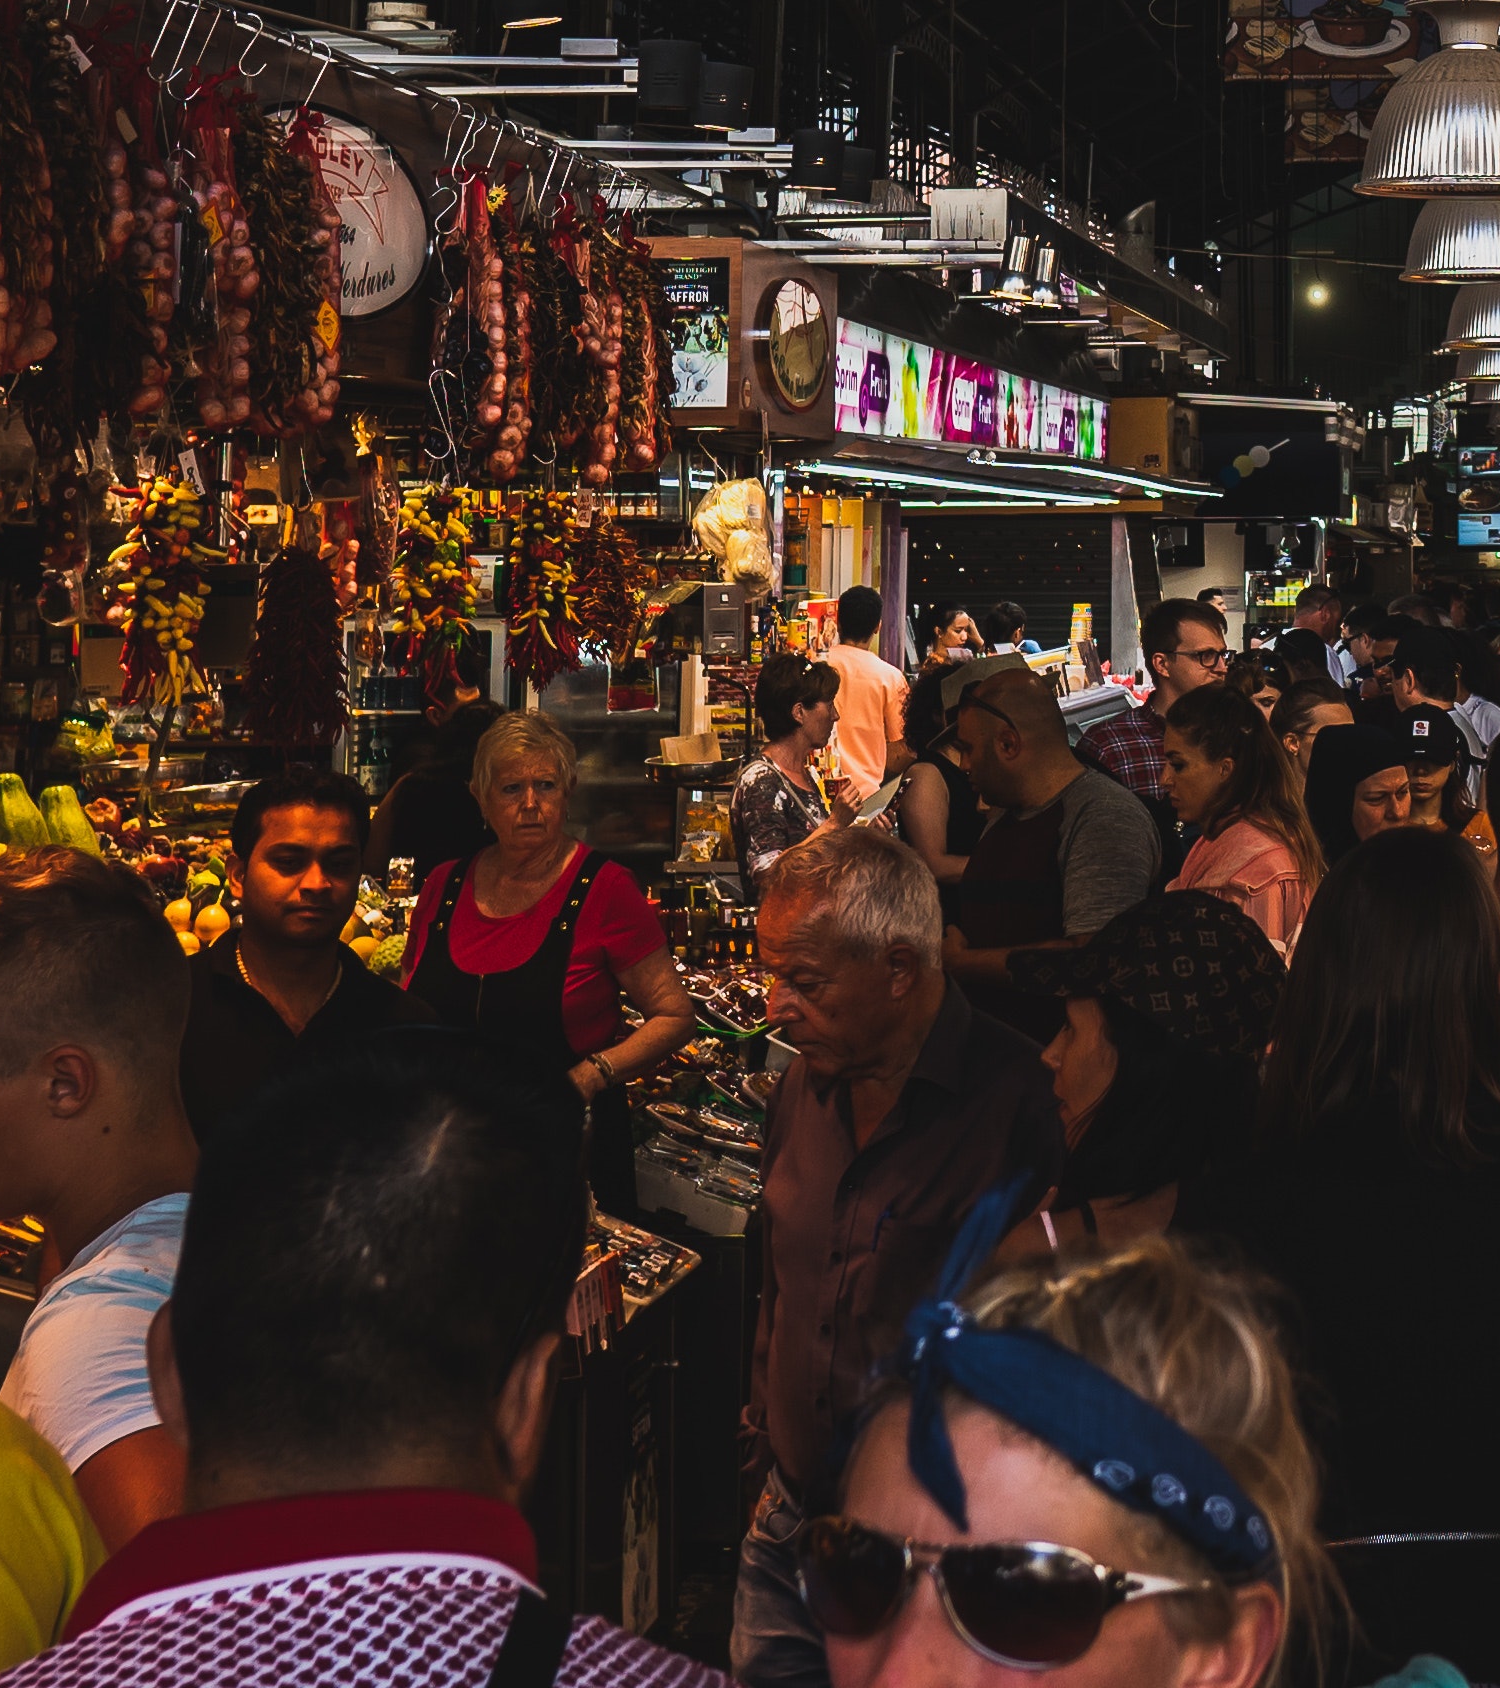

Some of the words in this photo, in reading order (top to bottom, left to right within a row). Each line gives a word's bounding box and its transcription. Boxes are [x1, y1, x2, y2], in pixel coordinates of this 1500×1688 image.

[315, 136, 365, 177] OLEY
[835, 355, 858, 401] Sprim
[870, 363, 888, 400] Fruit
[978, 394, 993, 425] Fruit
